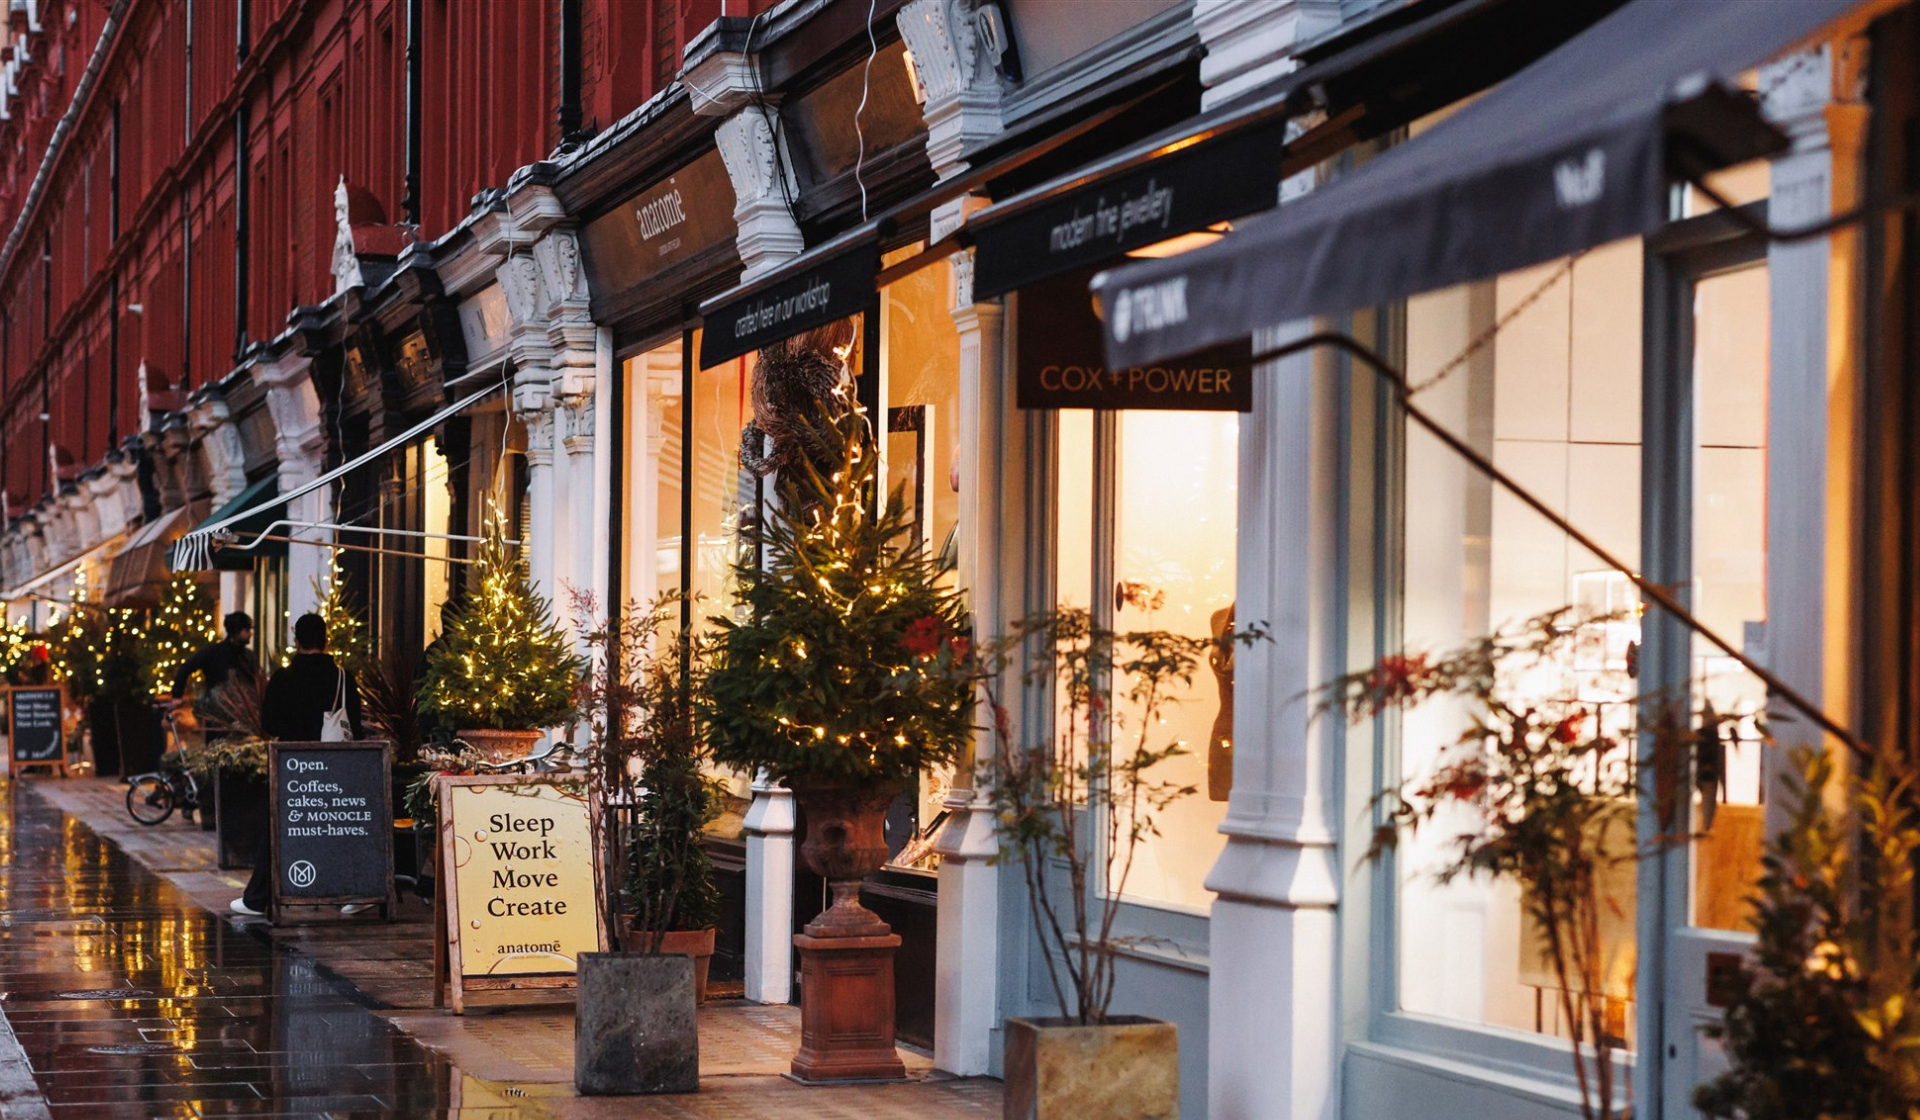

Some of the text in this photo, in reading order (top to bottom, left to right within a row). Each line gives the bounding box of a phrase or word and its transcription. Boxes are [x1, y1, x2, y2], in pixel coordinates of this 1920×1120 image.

[637, 177, 686, 241] anatomē
[1051, 179, 1174, 252] modern fine jewellery
[1040, 365, 1103, 391] COX
[1129, 366, 1233, 394] POWER
[286, 758, 328, 773] Open.
[287, 780, 343, 793] Coffees,
[287, 795, 366, 808] cakes, news
[288, 810, 372, 822] & MONOCLE
[490, 813, 554, 837] Sleep
[288, 824, 369, 836] must-haves.
[490, 840, 557, 860] Work
[492, 869, 558, 889] Move
[487, 897, 567, 917] Create
[497, 940, 561, 954] anatomē
